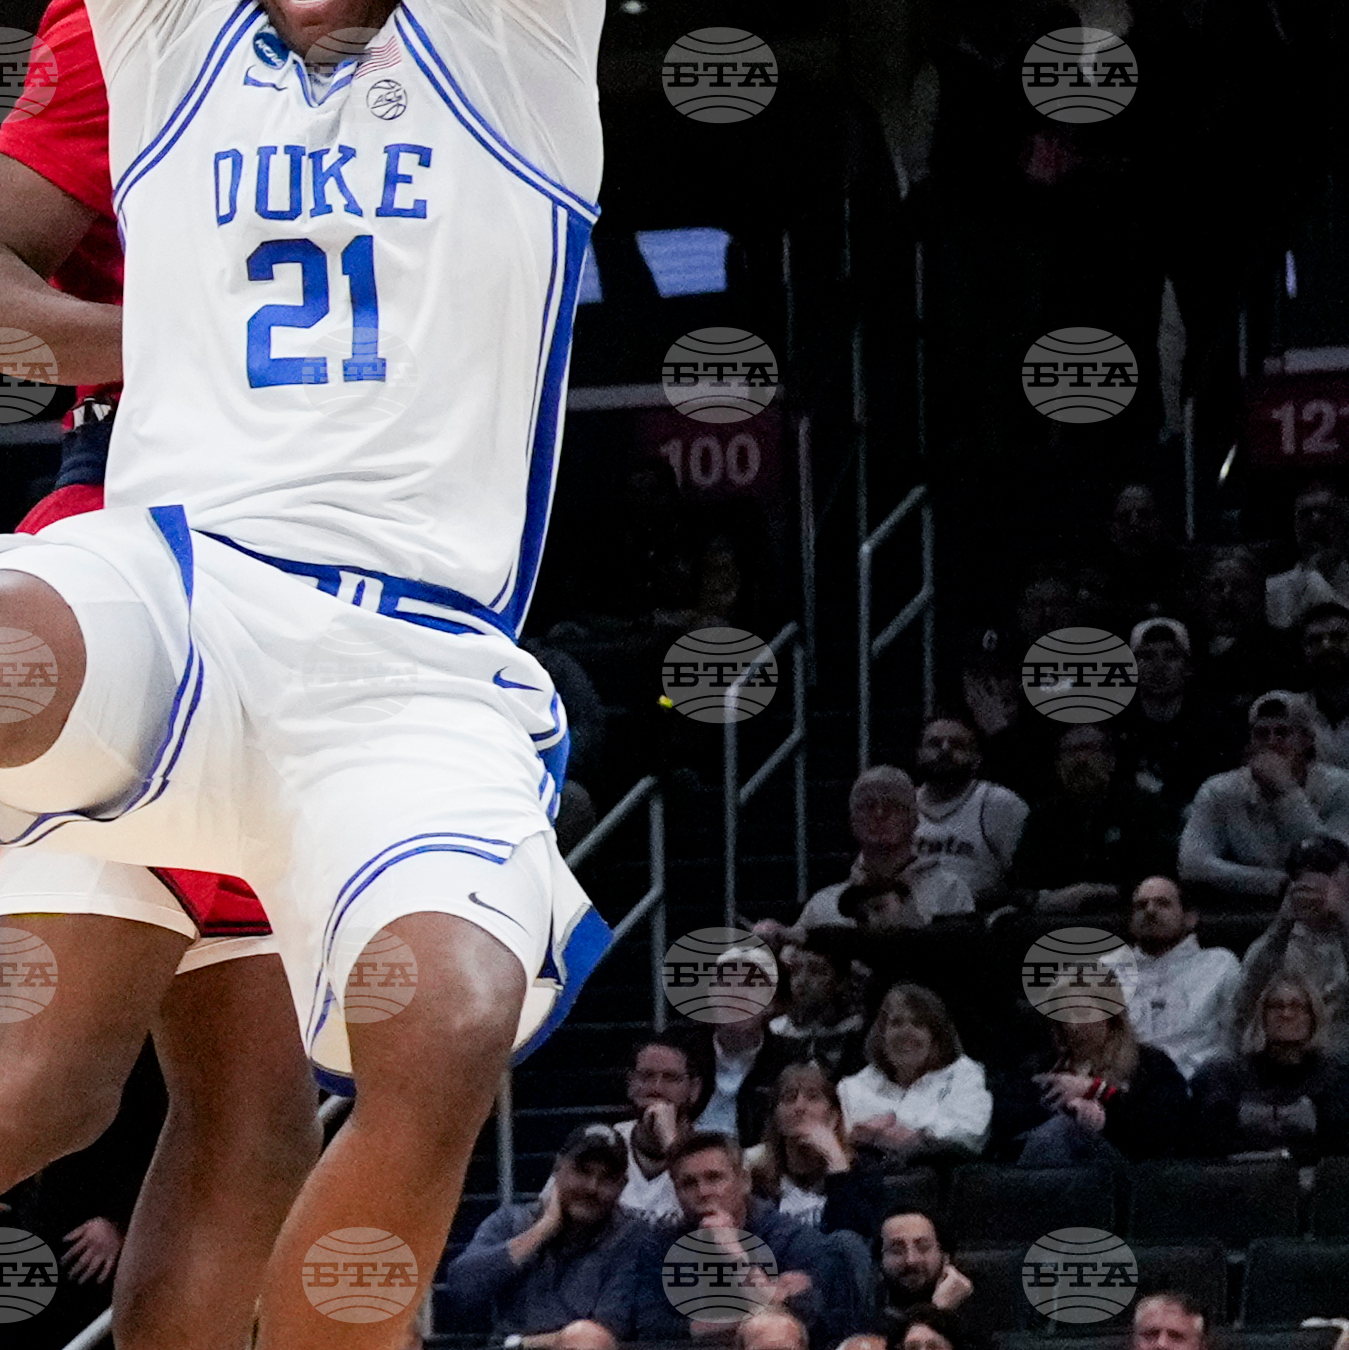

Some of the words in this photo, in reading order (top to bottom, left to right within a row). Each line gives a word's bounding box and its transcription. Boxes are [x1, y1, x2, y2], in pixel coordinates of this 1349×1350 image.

[213, 143, 433, 228] DUKE
[246, 234, 387, 389] 21
[659, 431, 762, 489] 100
[1271, 398, 1349, 455] 12
